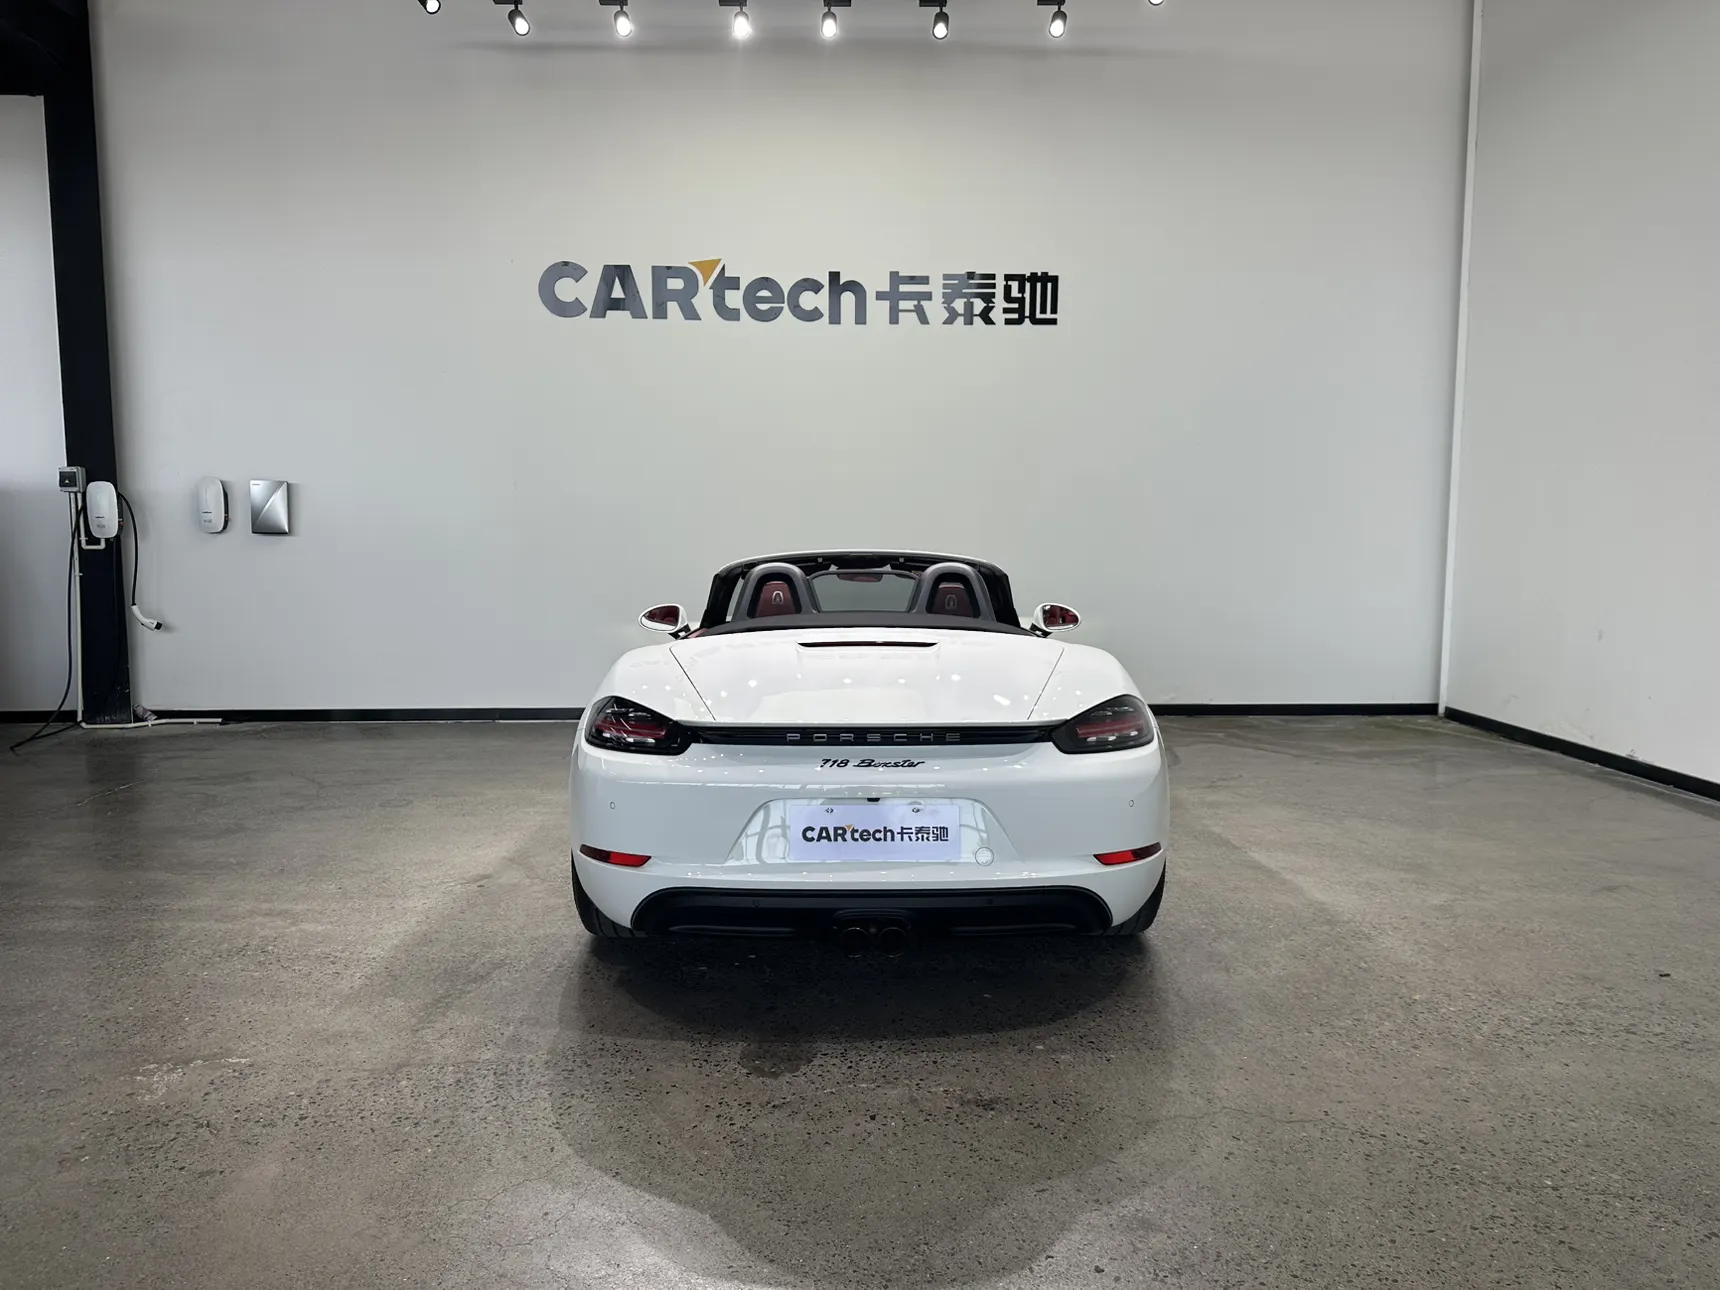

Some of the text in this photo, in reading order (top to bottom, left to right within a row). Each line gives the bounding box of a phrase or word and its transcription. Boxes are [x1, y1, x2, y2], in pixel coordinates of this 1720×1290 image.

[786, 733, 961, 742] PORSCHE
[820, 758, 926, 768] 718 Boxster
